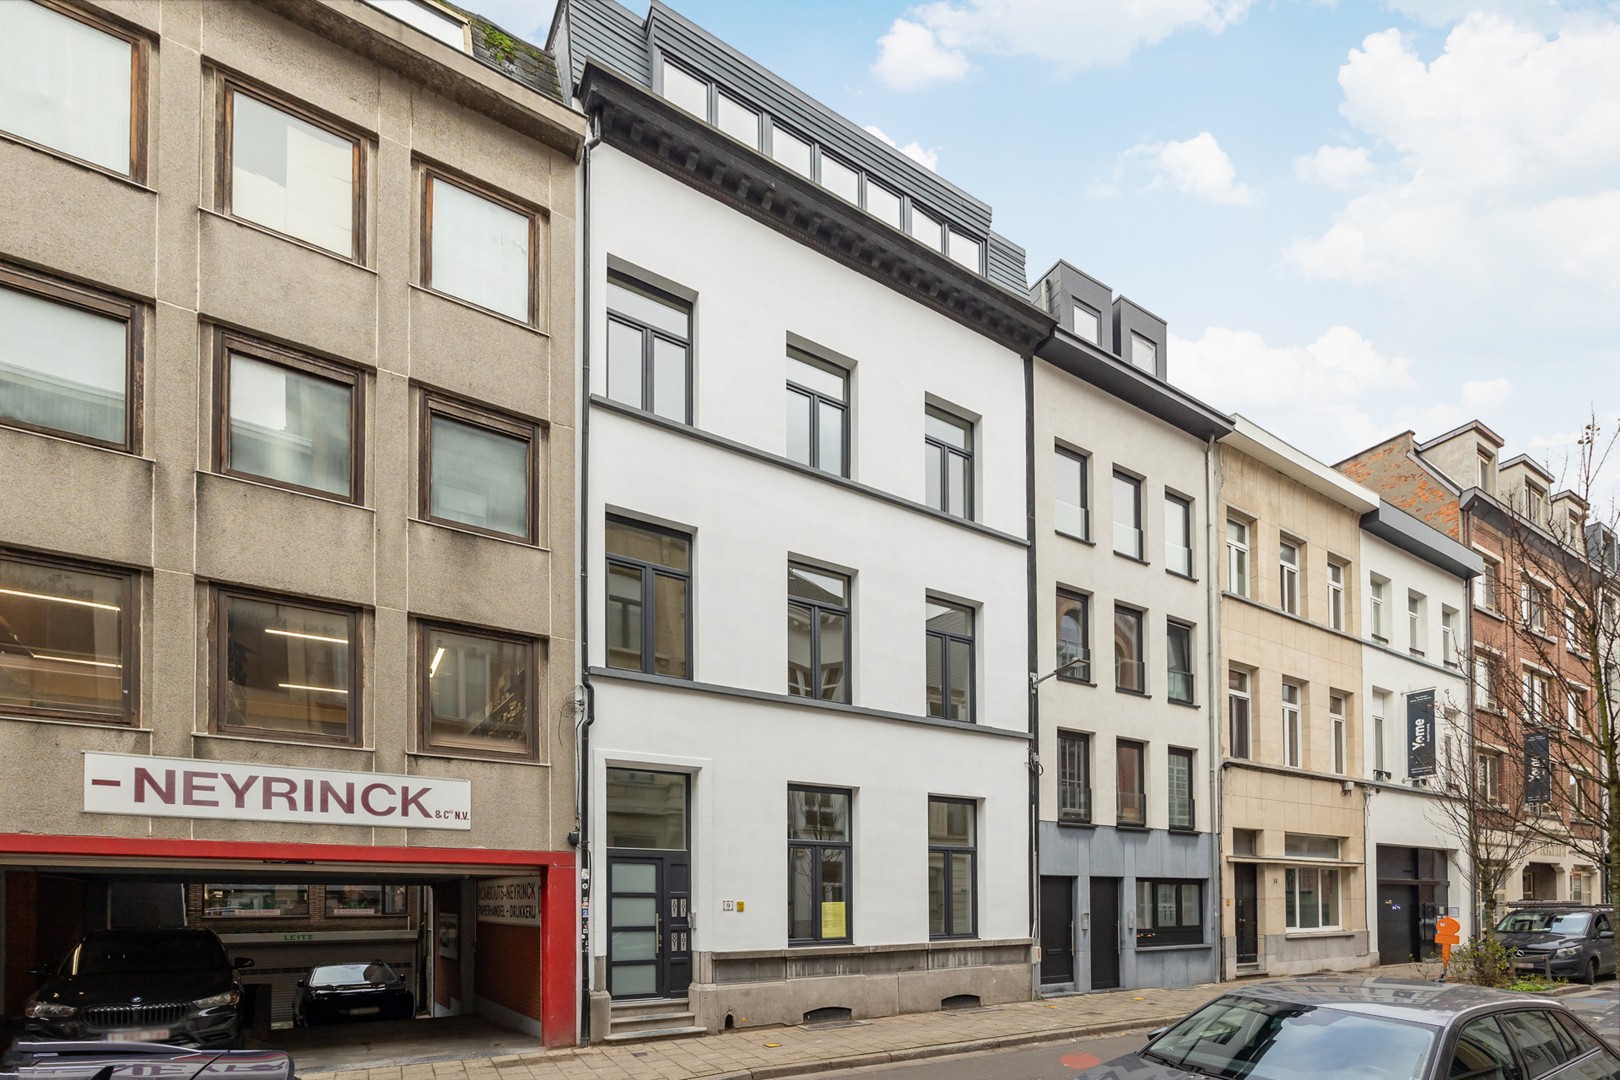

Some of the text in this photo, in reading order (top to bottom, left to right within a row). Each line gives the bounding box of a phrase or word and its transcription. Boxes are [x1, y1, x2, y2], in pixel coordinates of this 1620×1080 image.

[133, 766, 433, 819] NEYRINCK
[435, 809, 442, 819] &
[454, 810, 470, 821] N.V.
